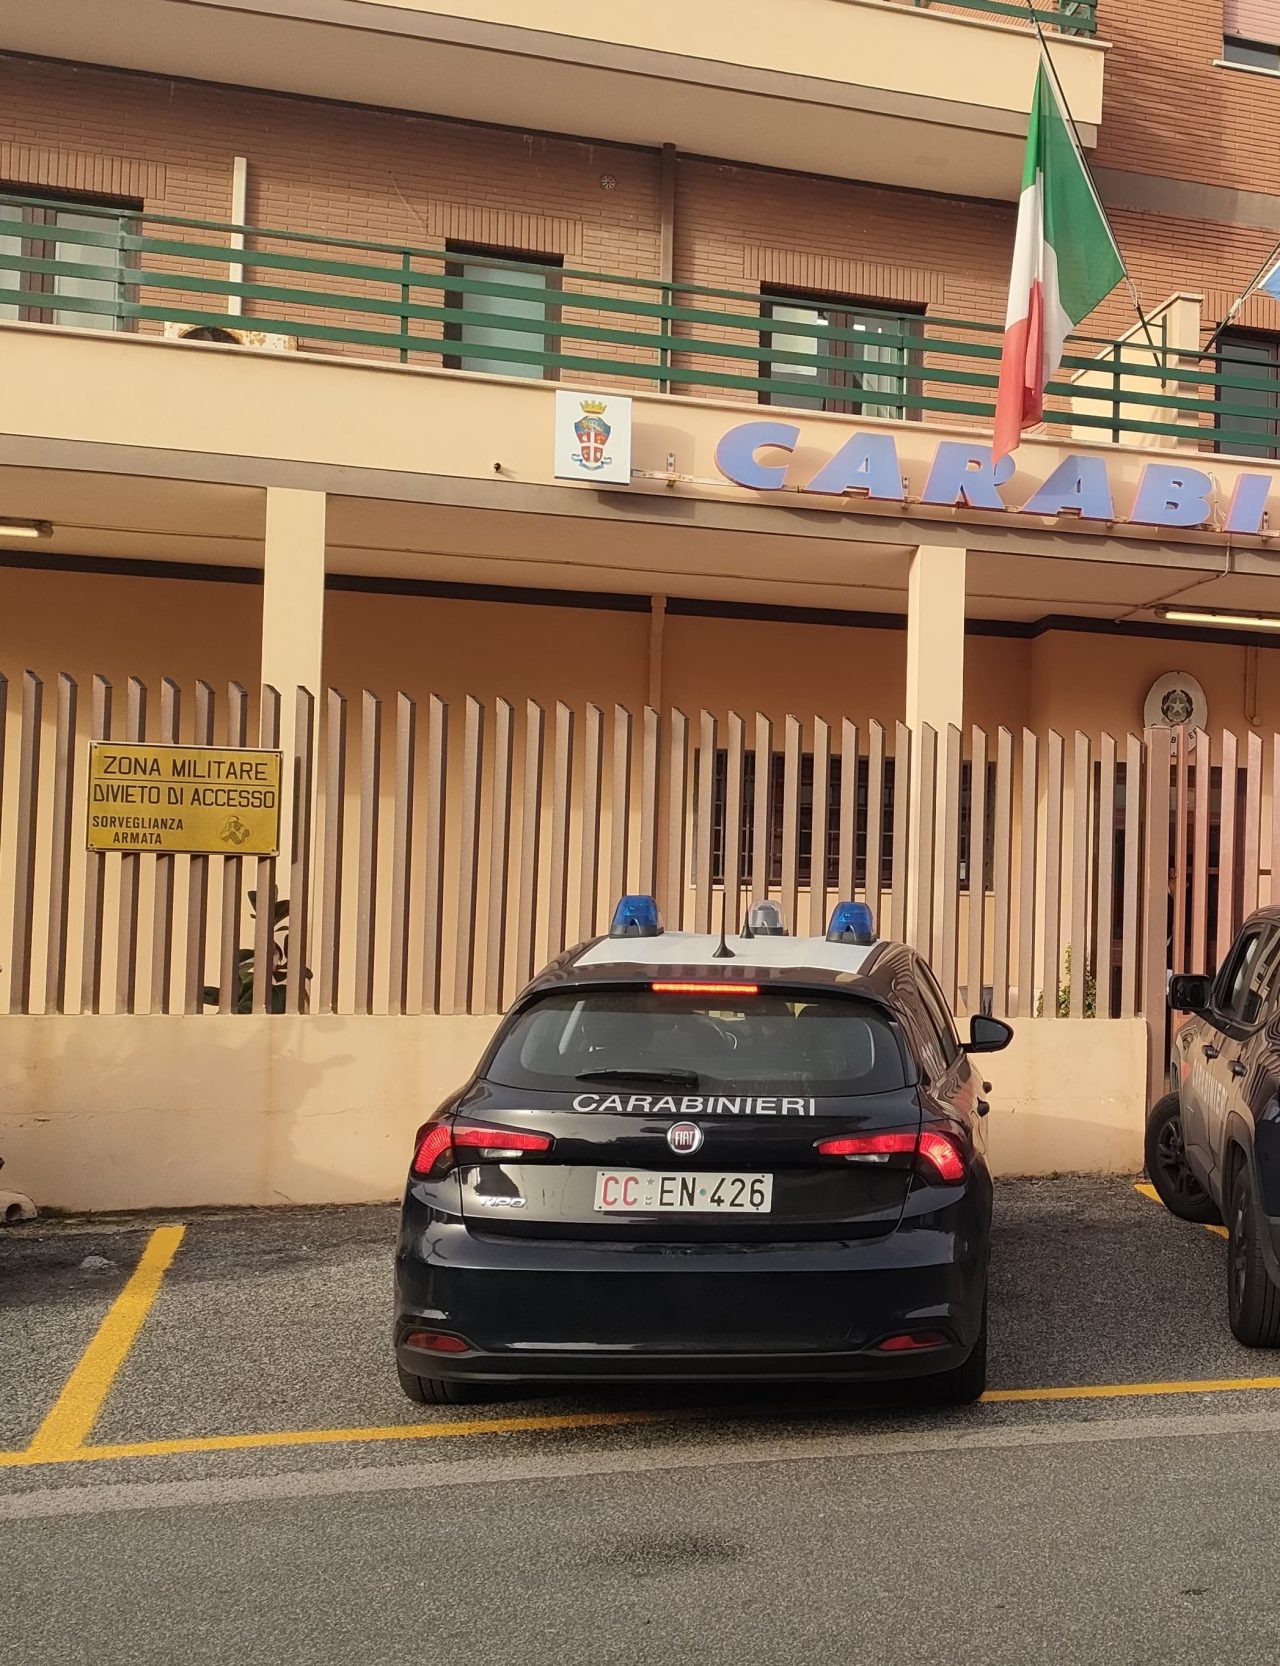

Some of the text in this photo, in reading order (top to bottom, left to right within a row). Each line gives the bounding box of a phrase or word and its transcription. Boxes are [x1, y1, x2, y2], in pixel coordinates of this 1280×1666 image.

[103, 755, 268, 781] ZONA MILITARE
[93, 784, 275, 809] DIVIETO DI ACCESSO
[92, 815, 183, 831] SORVEGLIANZA
[112, 832, 162, 845] ARMATA
[572, 1093, 816, 1116] CARABINIERI
[675, 1131, 694, 1146] FIAT
[602, 1175, 765, 1208] CC EN 426
